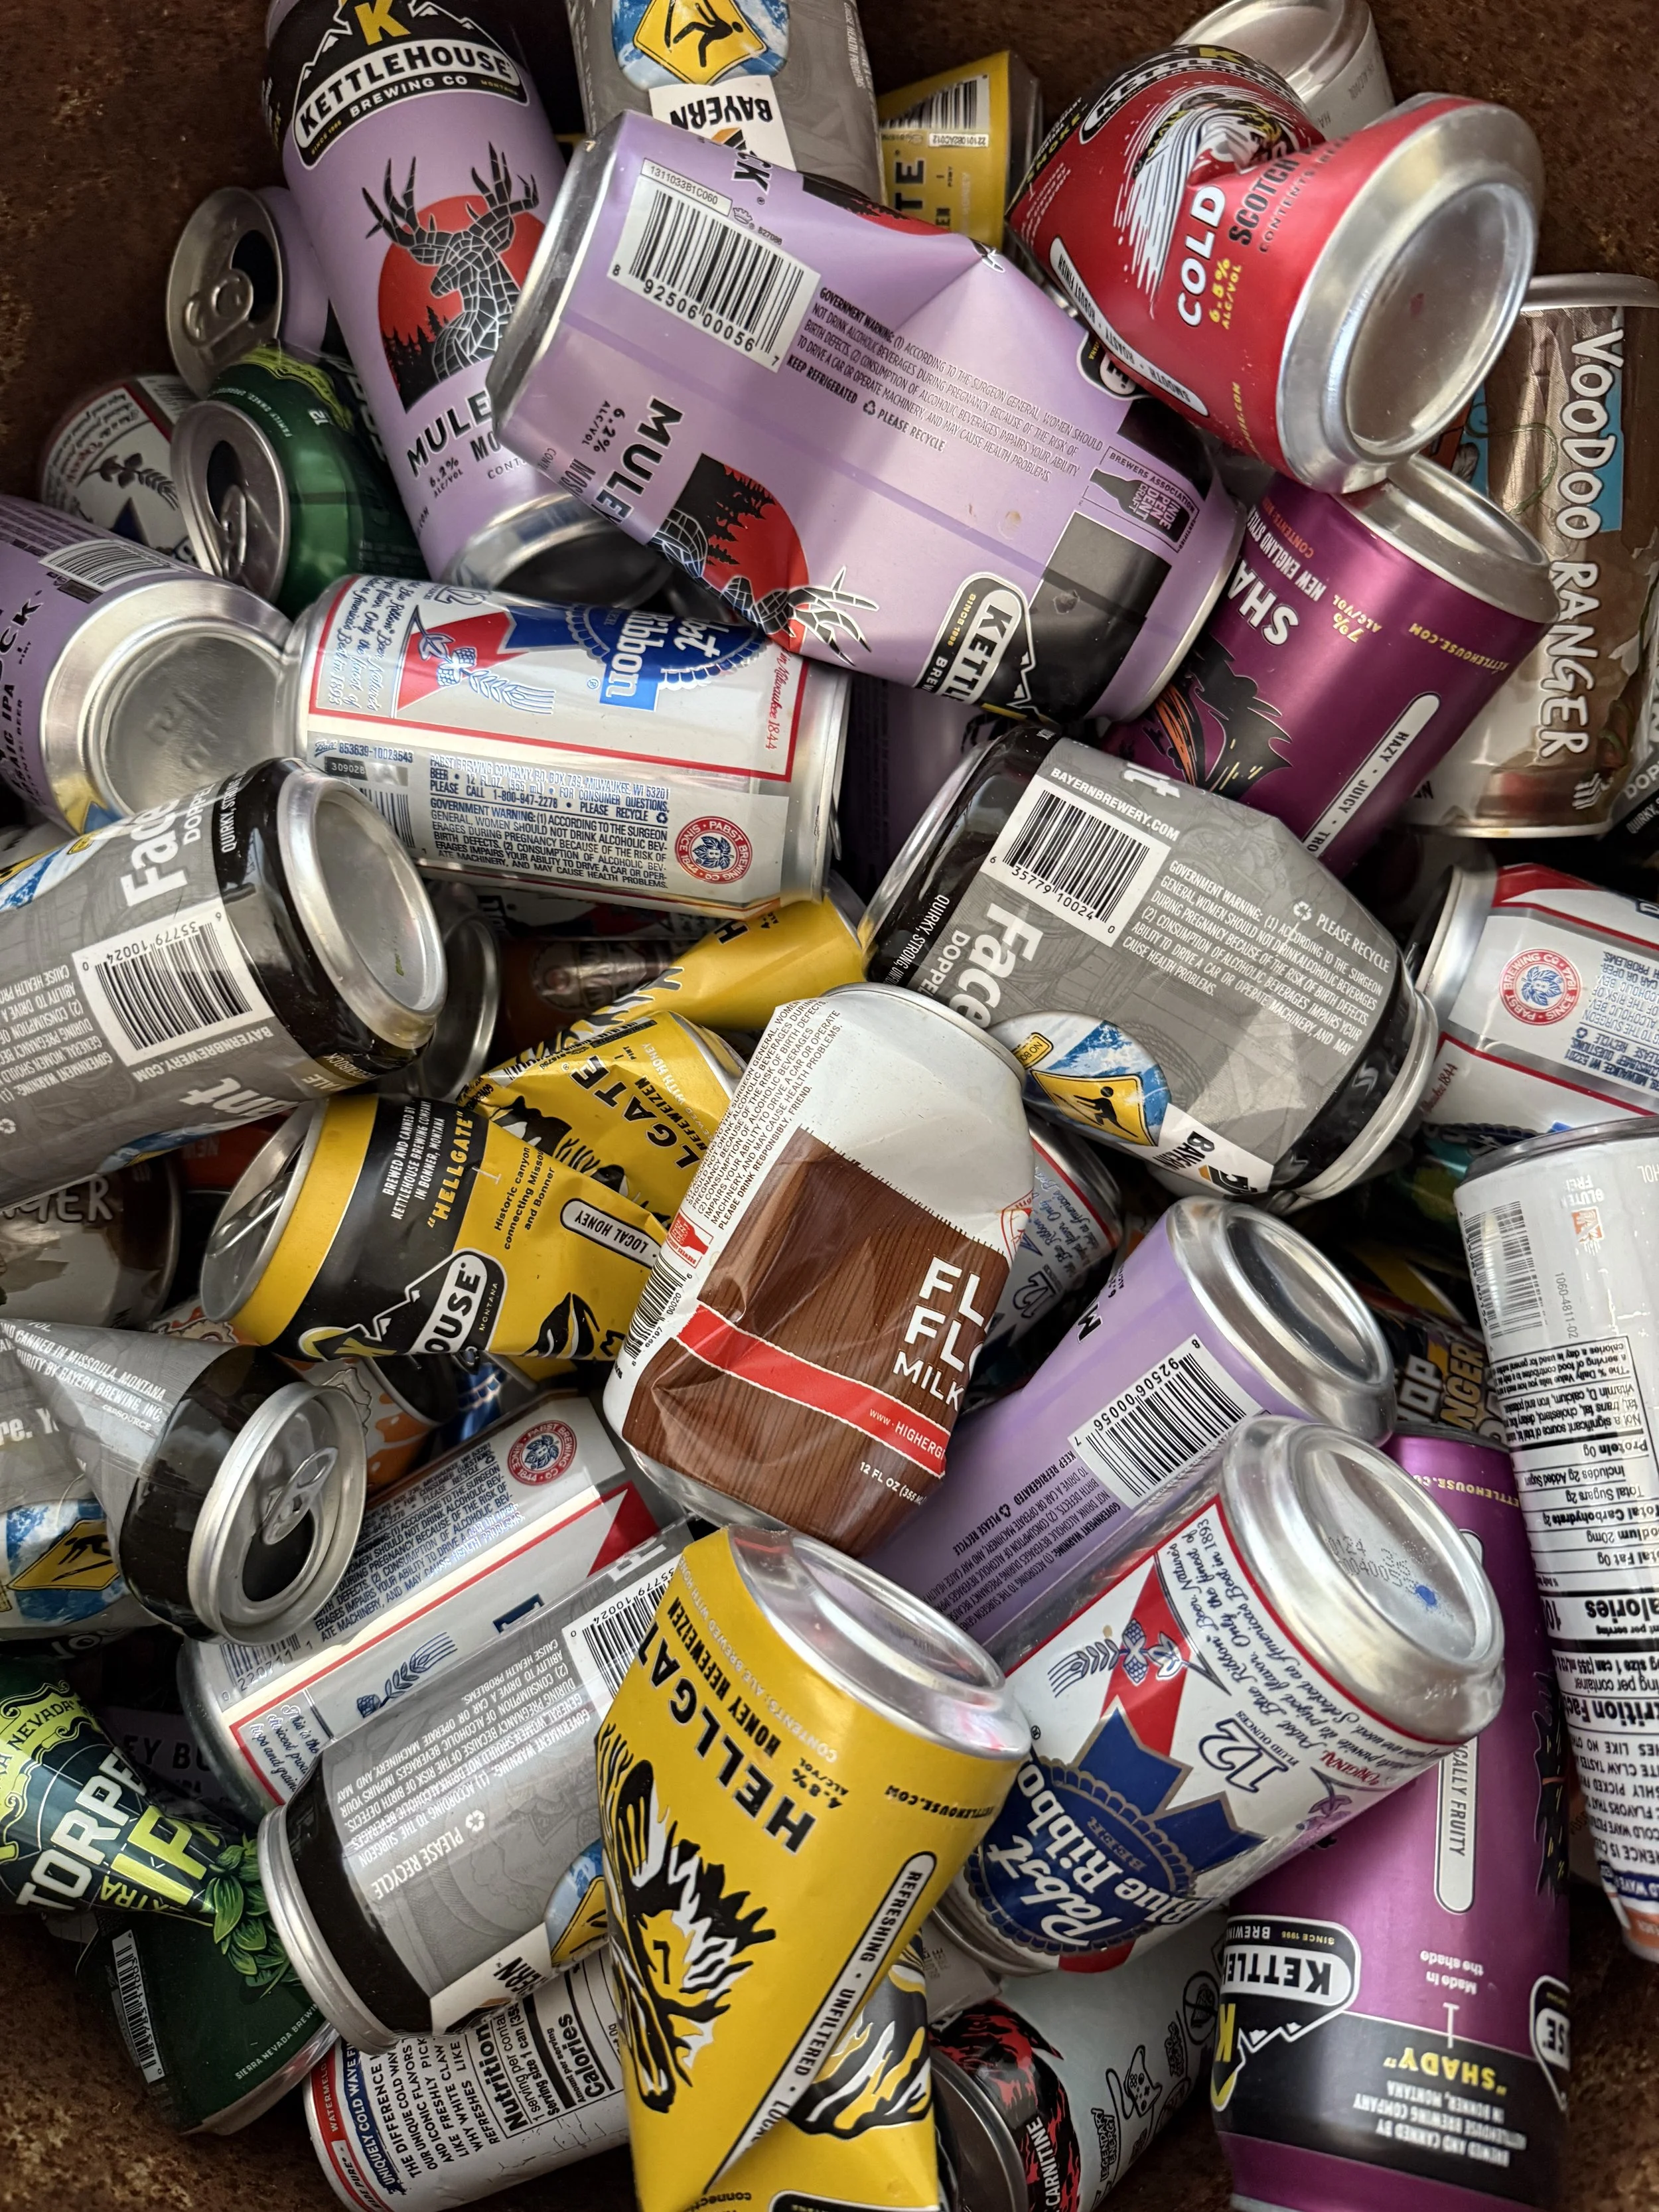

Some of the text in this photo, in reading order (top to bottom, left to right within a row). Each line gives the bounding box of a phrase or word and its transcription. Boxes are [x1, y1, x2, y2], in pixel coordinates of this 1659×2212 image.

[299, 42, 516, 135] KETTLEHOUSE
[348, 74, 469, 117] BREWING CO
[670, 95, 774, 131] BAYERN
[1226, 155, 1301, 246] SCOTCH
[1172, 181, 1231, 328] COLD
[643, 279, 756, 354] 92506 00056
[1205, 256, 1232, 324] 6.5%
[1220, 263, 1243, 329] ALC/VOL
[581, 400, 611, 447] ALC/VOL
[591, 406, 626, 455] 6.2%
[876, 408, 910, 434] PLEASE
[908, 425, 946, 453] RECYCLE
[1108, 452, 1149, 479] BREWERS
[1133, 486, 1161, 520] DENT
[1149, 494, 1171, 520] PEN
[1257, 530, 1327, 602] NEW ENGLAND
[1536, 330, 1626, 760] VOODOO RANGER
[1328, 610, 1364, 644] 7%
[1329, 593, 1382, 636] ALC/VOL
[492, 788, 558, 808] 1-800-947-2278
[1337, 729, 1409, 814] HAZY JUICY
[429, 797, 668, 841] GOVERNMENT WARNING: (1) ACCORDING TO THE SURGEON
[1050, 767, 1180, 842] BAYERNBREWERY.COM
[1011, 866, 1095, 922] 35779 10024
[1168, 858, 1265, 922] GOVERNMENT WARNING:
[104, 920, 199, 966] 35779 10024
[893, 893, 950, 970] QUIRKY, STRONG,
[1314, 913, 1394, 974] PLEASE RECYCLE
[945, 903, 1045, 1030] Face
[131, 1024, 273, 1083] BAYERNBREWERY.COM
[381, 1104, 415, 1196] BREWED AND CANNED BY
[390, 1159, 421, 1220] KETTLEHOUSE
[409, 1124, 429, 1160] BREWING
[413, 1116, 445, 1200] IN BONNER, MONTANA
[715, 1083, 813, 1230] PLEASE DRINK RESPONSIBLY, FRIEND.
[492, 1145, 533, 1231] Historic canyon
[501, 1186, 534, 1250] connecting
[523, 1166, 558, 1230] and Bonner
[573, 1209, 648, 1254] LOCAL HONEY
[666, 1291, 682, 1316] 00020
[13, 1330, 54, 1355] CANNED
[117, 1371, 167, 1402] MONTANA
[57, 1366, 144, 1414] BAYERN BREWING,
[889, 1349, 969, 1412] MILK
[1091, 1355, 1180, 1432] 92506 00056
[857, 1460, 901, 1492] 12 FL OZ
[1582, 1438, 1648, 1457] Protein 0g
[950, 1449, 1077, 1556] KEEP REFRIGERATED PLEASE RECYCLE
[1578, 1484, 1643, 1502] Total Sugars
[1194, 1516, 1220, 1552] 1893
[1217, 1607, 1255, 1651] Only
[664, 1595, 785, 1758] HONEY HEFEWEIZEN
[7, 1698, 74, 1749] NEVADA
[639, 1619, 818, 1856] HELLGAT
[1235, 1708, 1299, 1768] FLUID OUNCES
[796, 1755, 850, 1797] ALC/VOL
[1190, 1712, 1289, 1803] 12
[786, 1765, 843, 1814] 4.8%
[368, 1824, 466, 1900] PLEASE RECYCLE
[1447, 1803, 1469, 1858] FRUITY
[982, 1831, 1121, 1945] Pabst
[1113, 1875, 1208, 1924] Blue
[793, 1868, 923, 2079] REFRESHING UNFILTERED
[1418, 1949, 1485, 1976] the shade
[1439, 1973, 1479, 1995] Made
[234, 2029, 293, 2081] SIERRA NEVADA
[467, 2022, 529, 2132] Nutrition
[553, 2012, 607, 2099] Calories
[368, 2062, 423, 2179] THE DIFFERENCE
[399, 2043, 441, 2142] ICONIC FLAVORS
[424, 2073, 455, 2130] FRESHLY
[433, 2043, 484, 2152] WHY WHITE CLAW
[461, 2079, 500, 2145] REFRESHES
[350, 2097, 396, 2185] UNIQUELY COLD
[402, 2108, 427, 2150] UNIQUE
